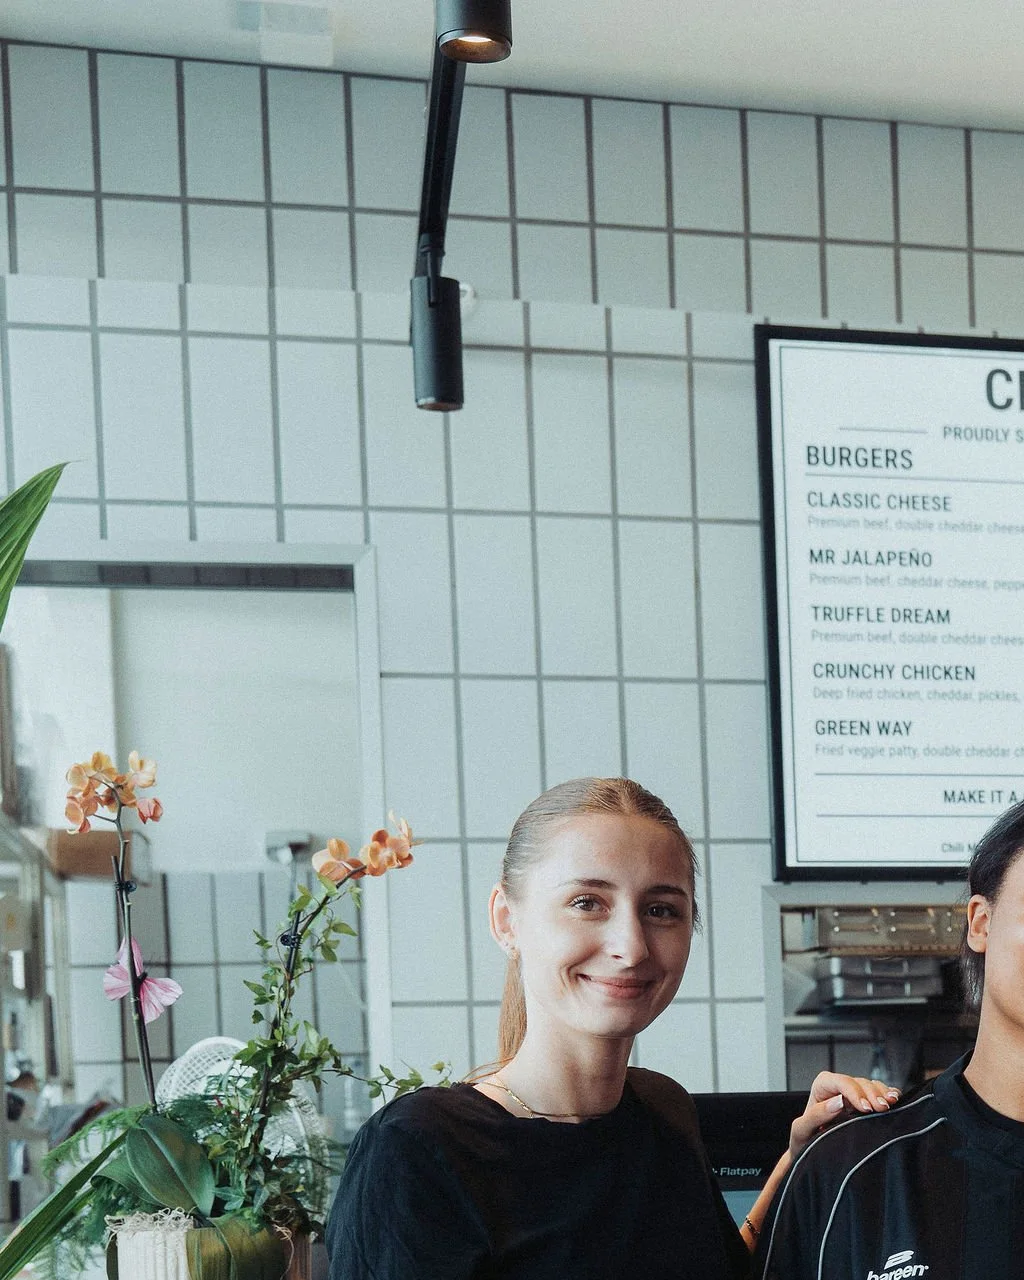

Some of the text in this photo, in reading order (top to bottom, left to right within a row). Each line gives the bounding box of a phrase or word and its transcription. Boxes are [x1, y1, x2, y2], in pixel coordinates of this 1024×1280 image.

[943, 426, 1010, 444] PROUDLY
[806, 445, 914, 470] BURGERS
[807, 491, 952, 512] CLASSIC CHEESE
[809, 548, 932, 567] MR JALAPEÑO
[812, 605, 951, 624] TRUFFLE DREAM
[813, 663, 976, 681] CRUNCHY CHICKEN
[813, 686, 843, 700] Deep
[846, 686, 872, 698] fried
[815, 719, 913, 736] GREEN WAY
[944, 789, 985, 803] MAKE
[991, 790, 1003, 803] IT
[1008, 790, 1018, 803] A
[720, 1167, 762, 1177] Flatpay
